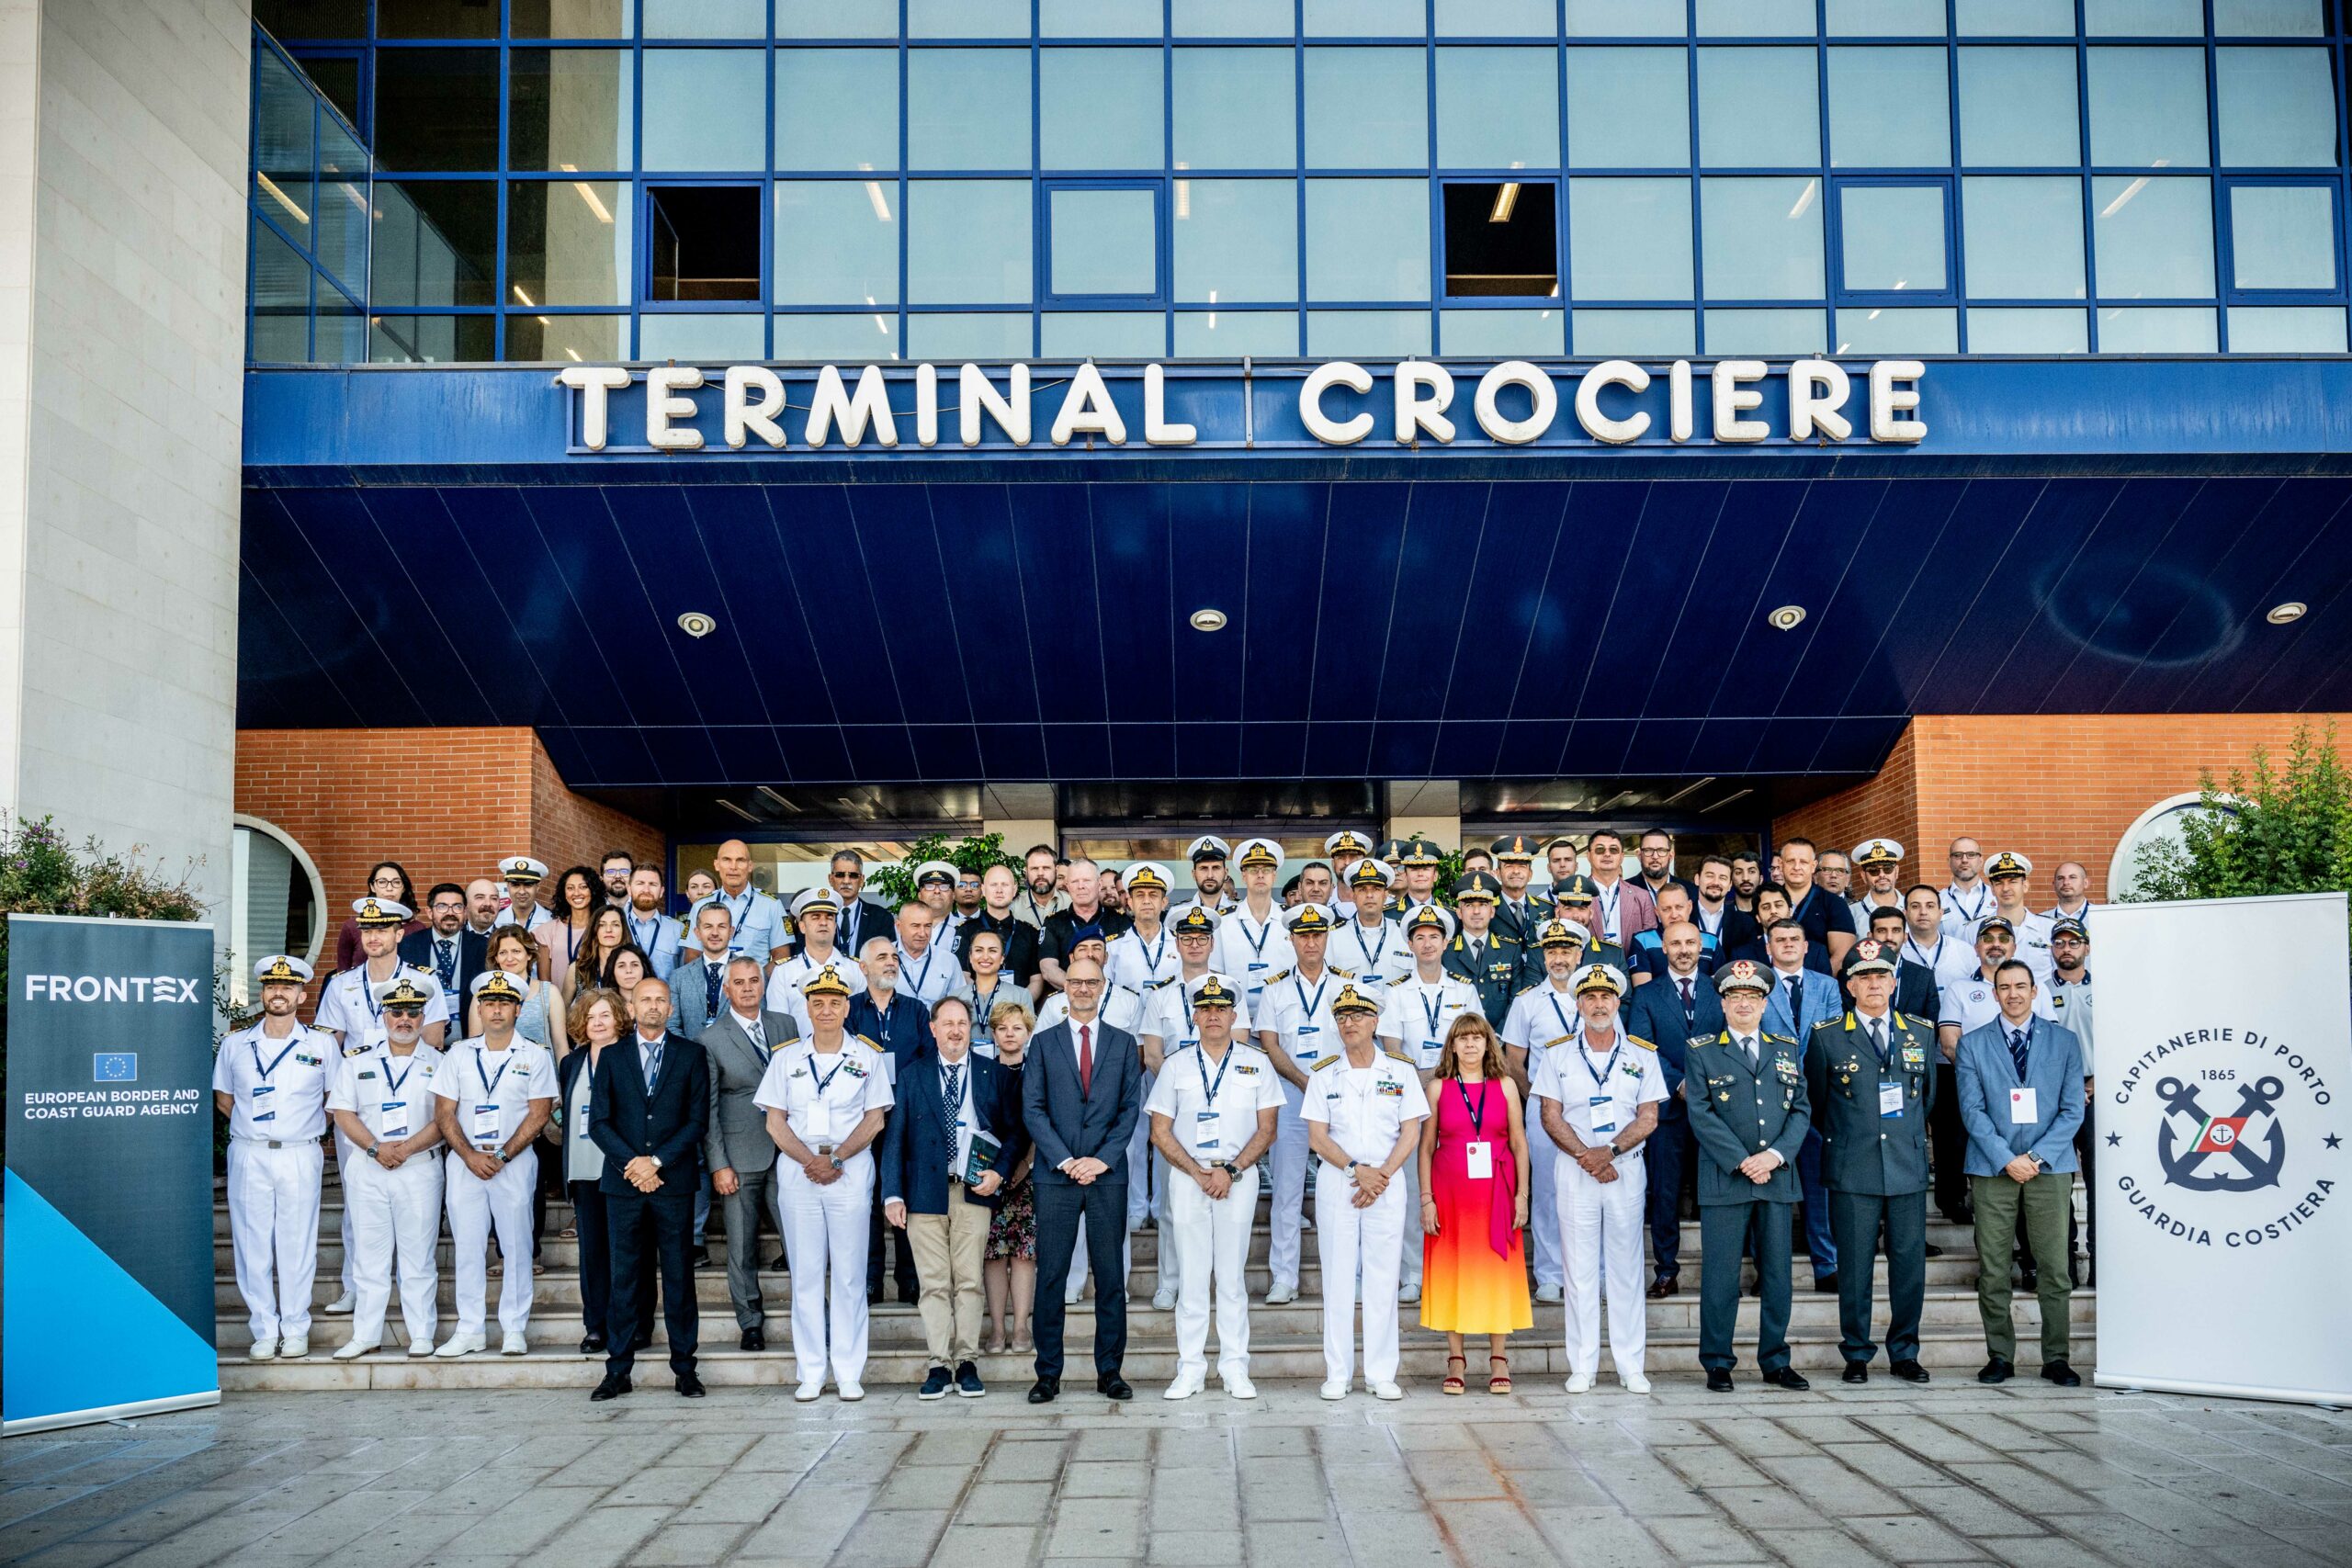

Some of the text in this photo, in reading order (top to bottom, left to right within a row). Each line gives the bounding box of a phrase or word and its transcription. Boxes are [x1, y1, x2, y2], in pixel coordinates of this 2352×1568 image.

[560, 359, 1928, 450] TERMINAL CROCIERE
[26, 975, 199, 1003] FRONTEX
[2115, 1028, 2331, 1105] CAPITANERIE DI PORTO
[2200, 1069, 2235, 1080] 1865
[25, 1089, 199, 1104] EUROPEAN BORDER AND
[25, 1103, 198, 1120] COAST GUARD AGENCY
[2118, 1176, 2335, 1247] GUARDIA COSTIERA
